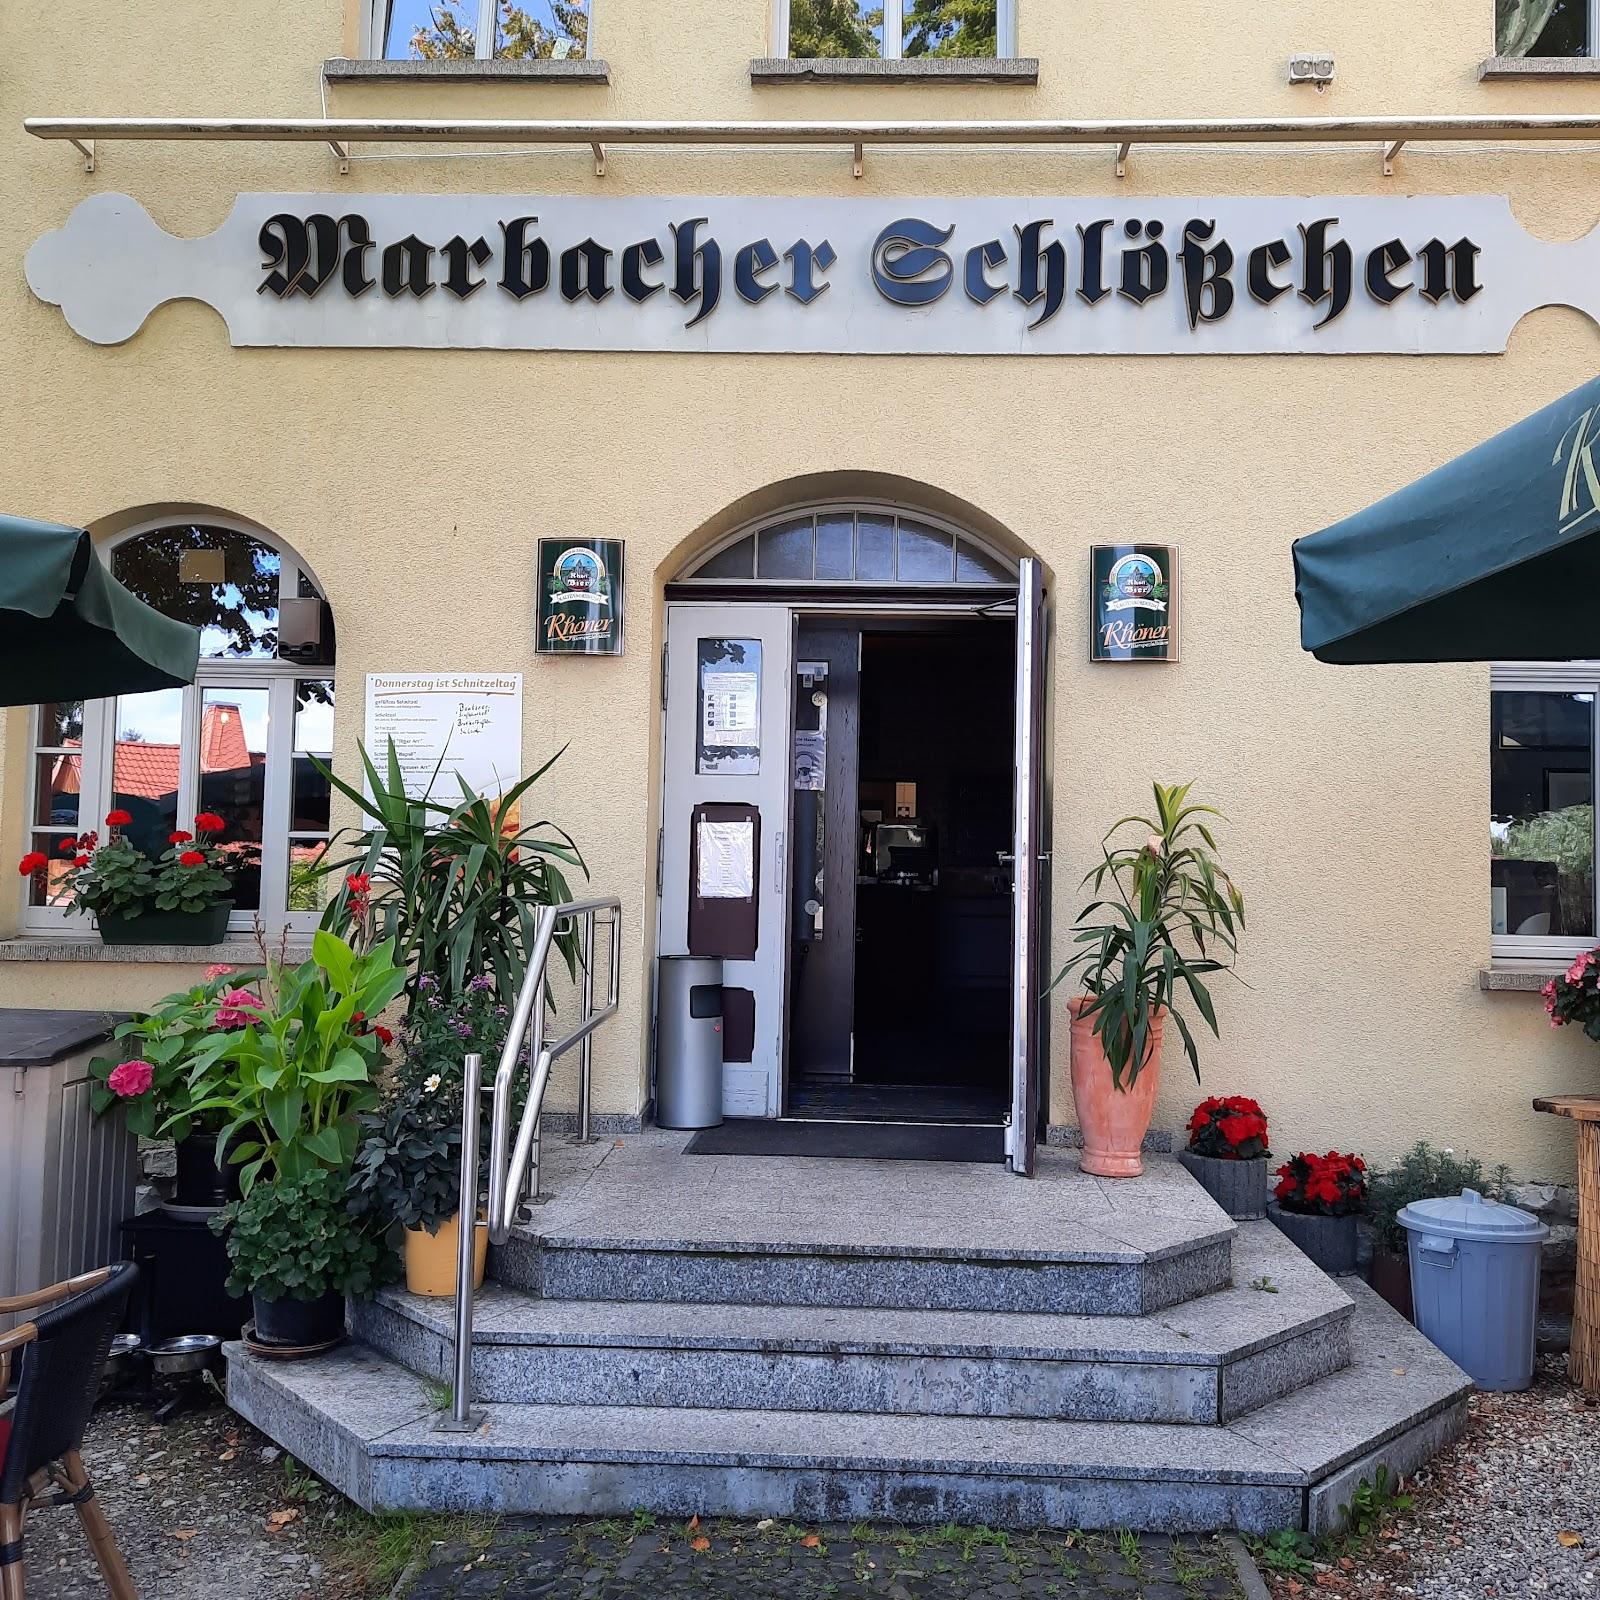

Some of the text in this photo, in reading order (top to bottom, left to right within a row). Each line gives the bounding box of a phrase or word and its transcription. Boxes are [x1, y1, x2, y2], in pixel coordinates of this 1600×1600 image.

[257, 214, 1484, 331] Marbacher Schlößchen
[544, 612, 614, 641] Rhöner
[1099, 620, 1171, 649] Rhöner
[374, 677, 516, 690] Donnerstag ist Schnitzeltag
